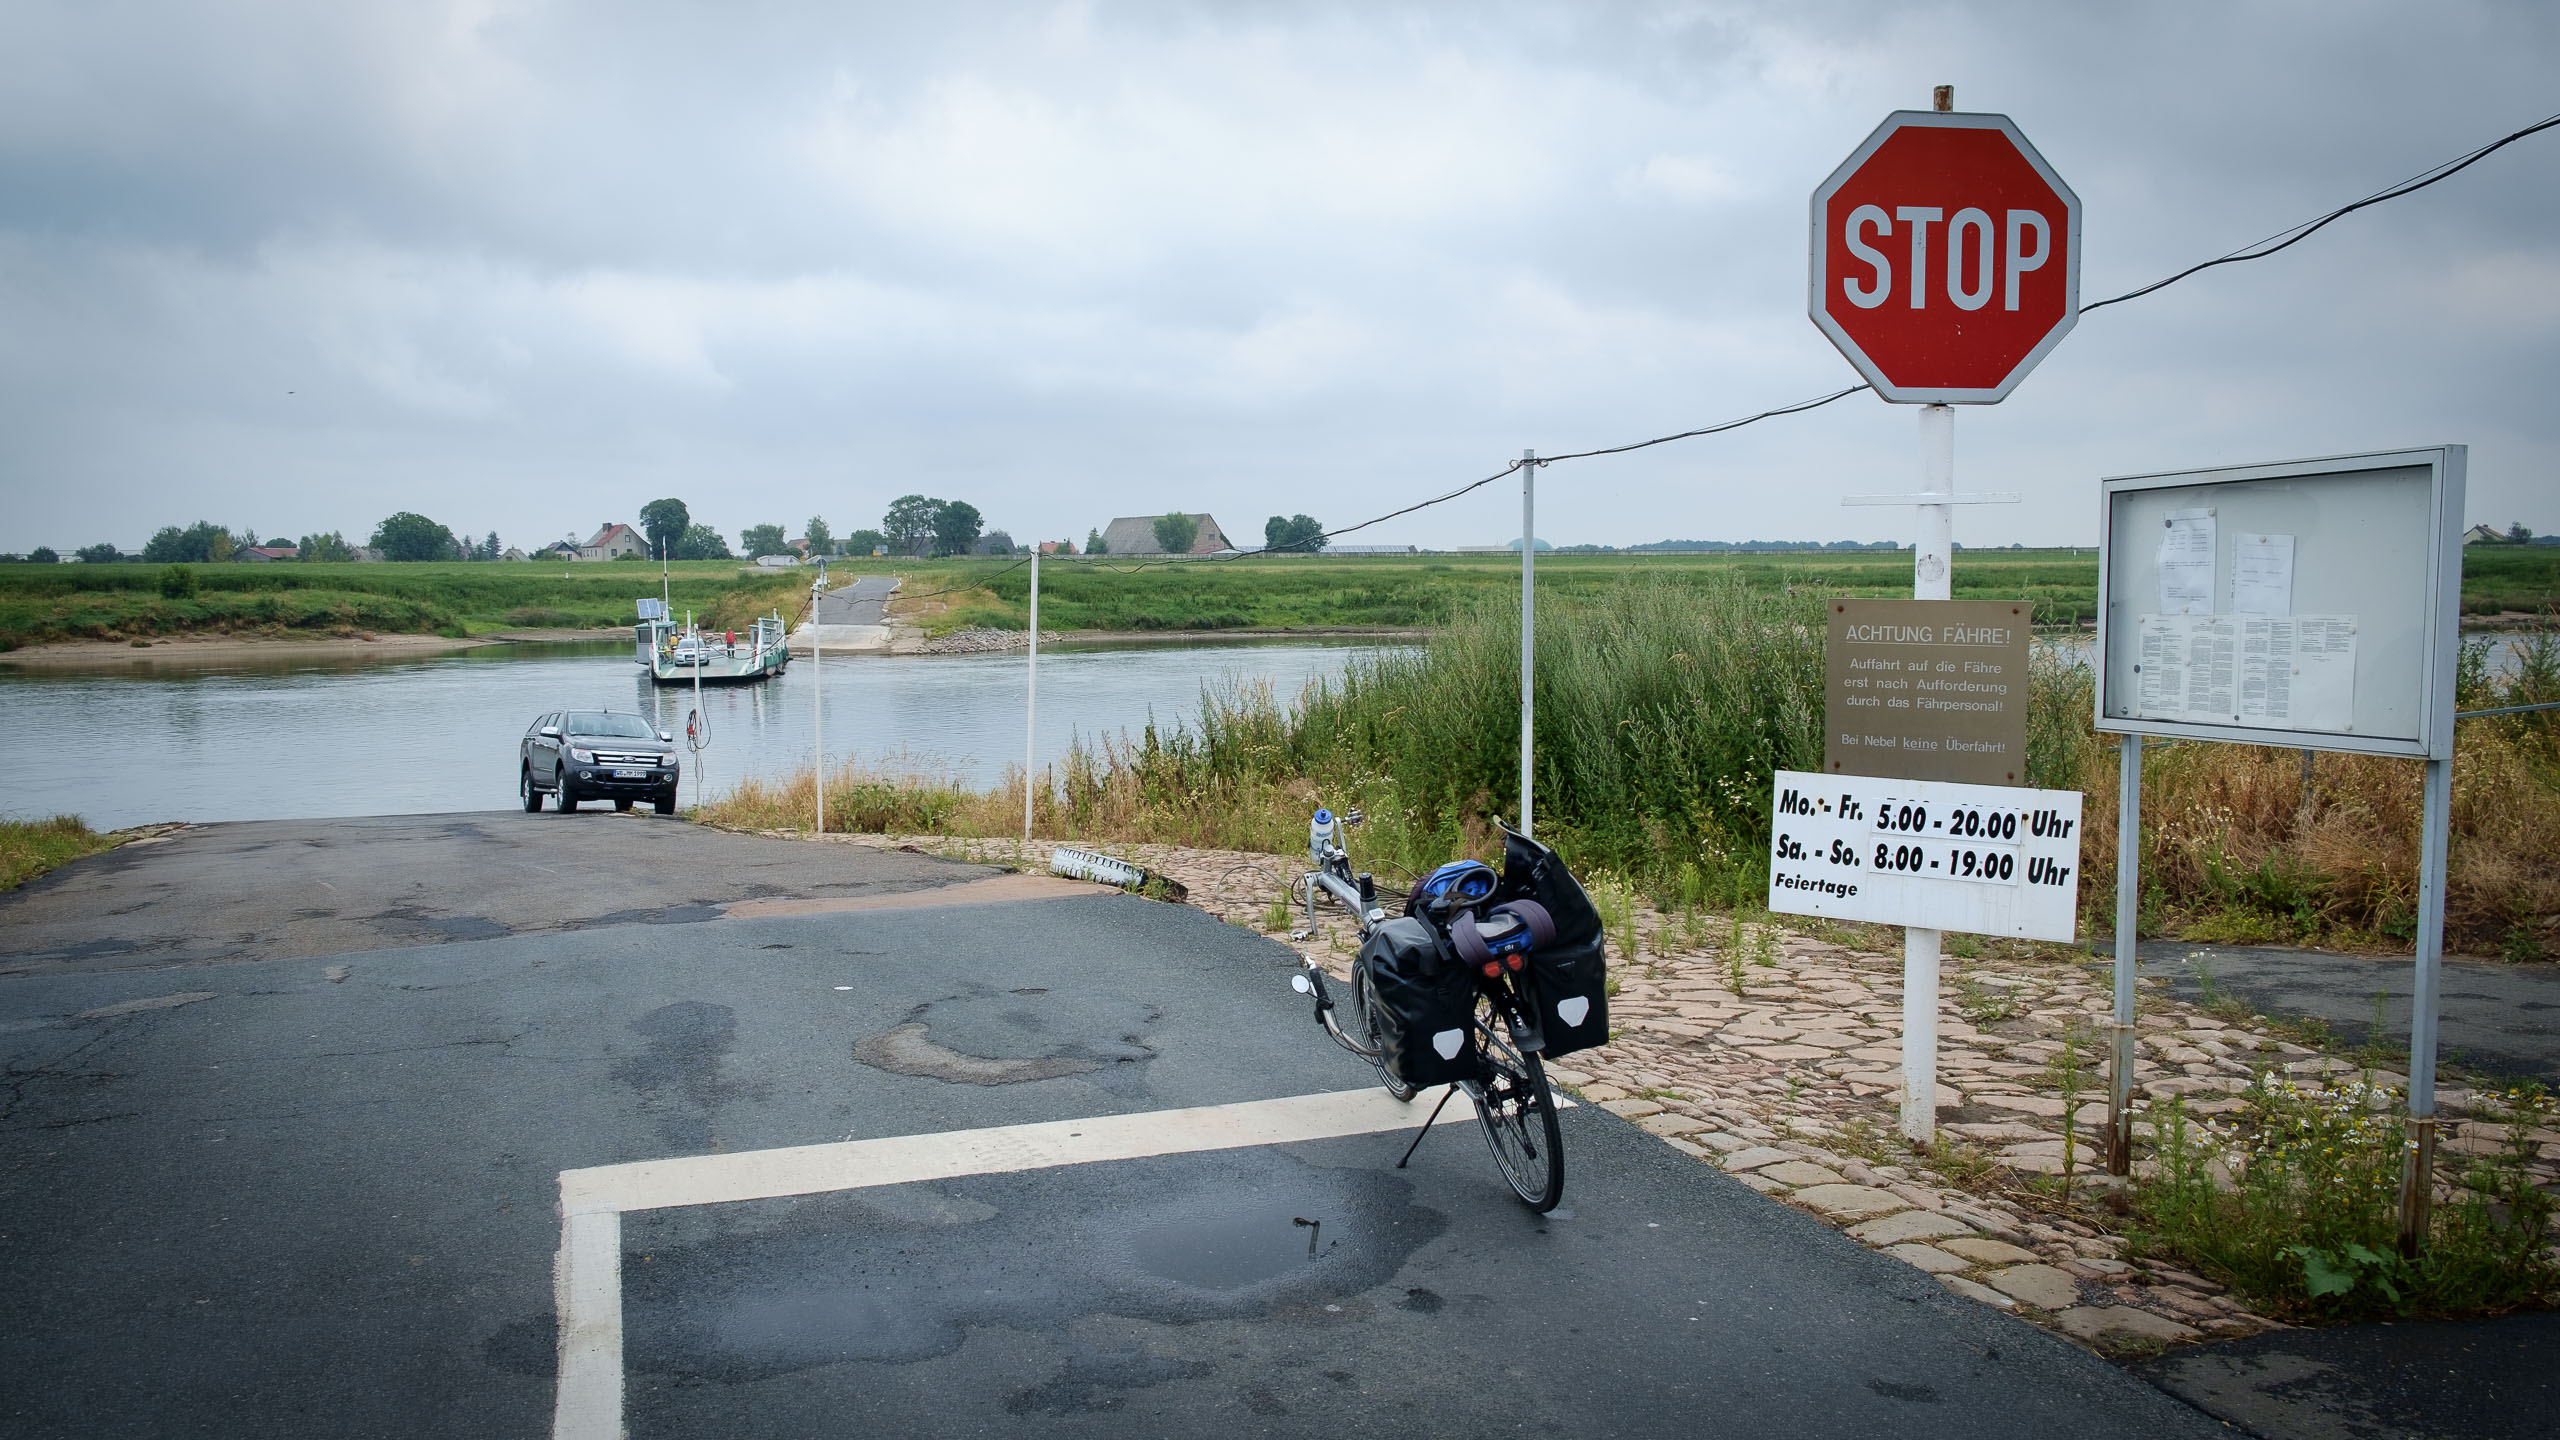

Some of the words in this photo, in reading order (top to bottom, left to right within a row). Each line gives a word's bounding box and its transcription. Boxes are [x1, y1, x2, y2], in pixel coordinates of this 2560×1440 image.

[1843, 204, 2051, 312] STOP
[1846, 625, 1933, 642] ACHTUNG
[1943, 622, 2011, 644] FÄHRE!
[1850, 658, 1901, 671] Auffahrt
[1907, 660, 1929, 672] auf
[1935, 661, 1956, 673] die
[1964, 661, 2002, 674] Fähre
[1843, 677, 1868, 688] erst
[1876, 678, 1908, 689] nach
[1916, 679, 2008, 695] Aufforderung
[1846, 695, 1880, 707] durch
[1887, 697, 1910, 708] das
[1917, 697, 2004, 712] Fährpersonal!
[1841, 734, 1859, 745] Bei
[1864, 735, 1896, 748] Nebel
[1903, 737, 1938, 750] keine
[1945, 736, 2006, 753] Überfahrt!
[1779, 789, 1815, 817] Mo.
[1838, 794, 1863, 821] Fr.
[1876, 804, 1926, 833] 5.00
[1949, 809, 2016, 840] 20.00
[2031, 809, 2074, 839] Uhr
[1776, 833, 1807, 861] Sa.
[1829, 838, 1860, 867] So.
[1874, 843, 1923, 873] 8.00
[1949, 849, 2014, 881] 19.00
[2027, 856, 2071, 887] Uhr
[1775, 873, 1858, 899] Feiertage
